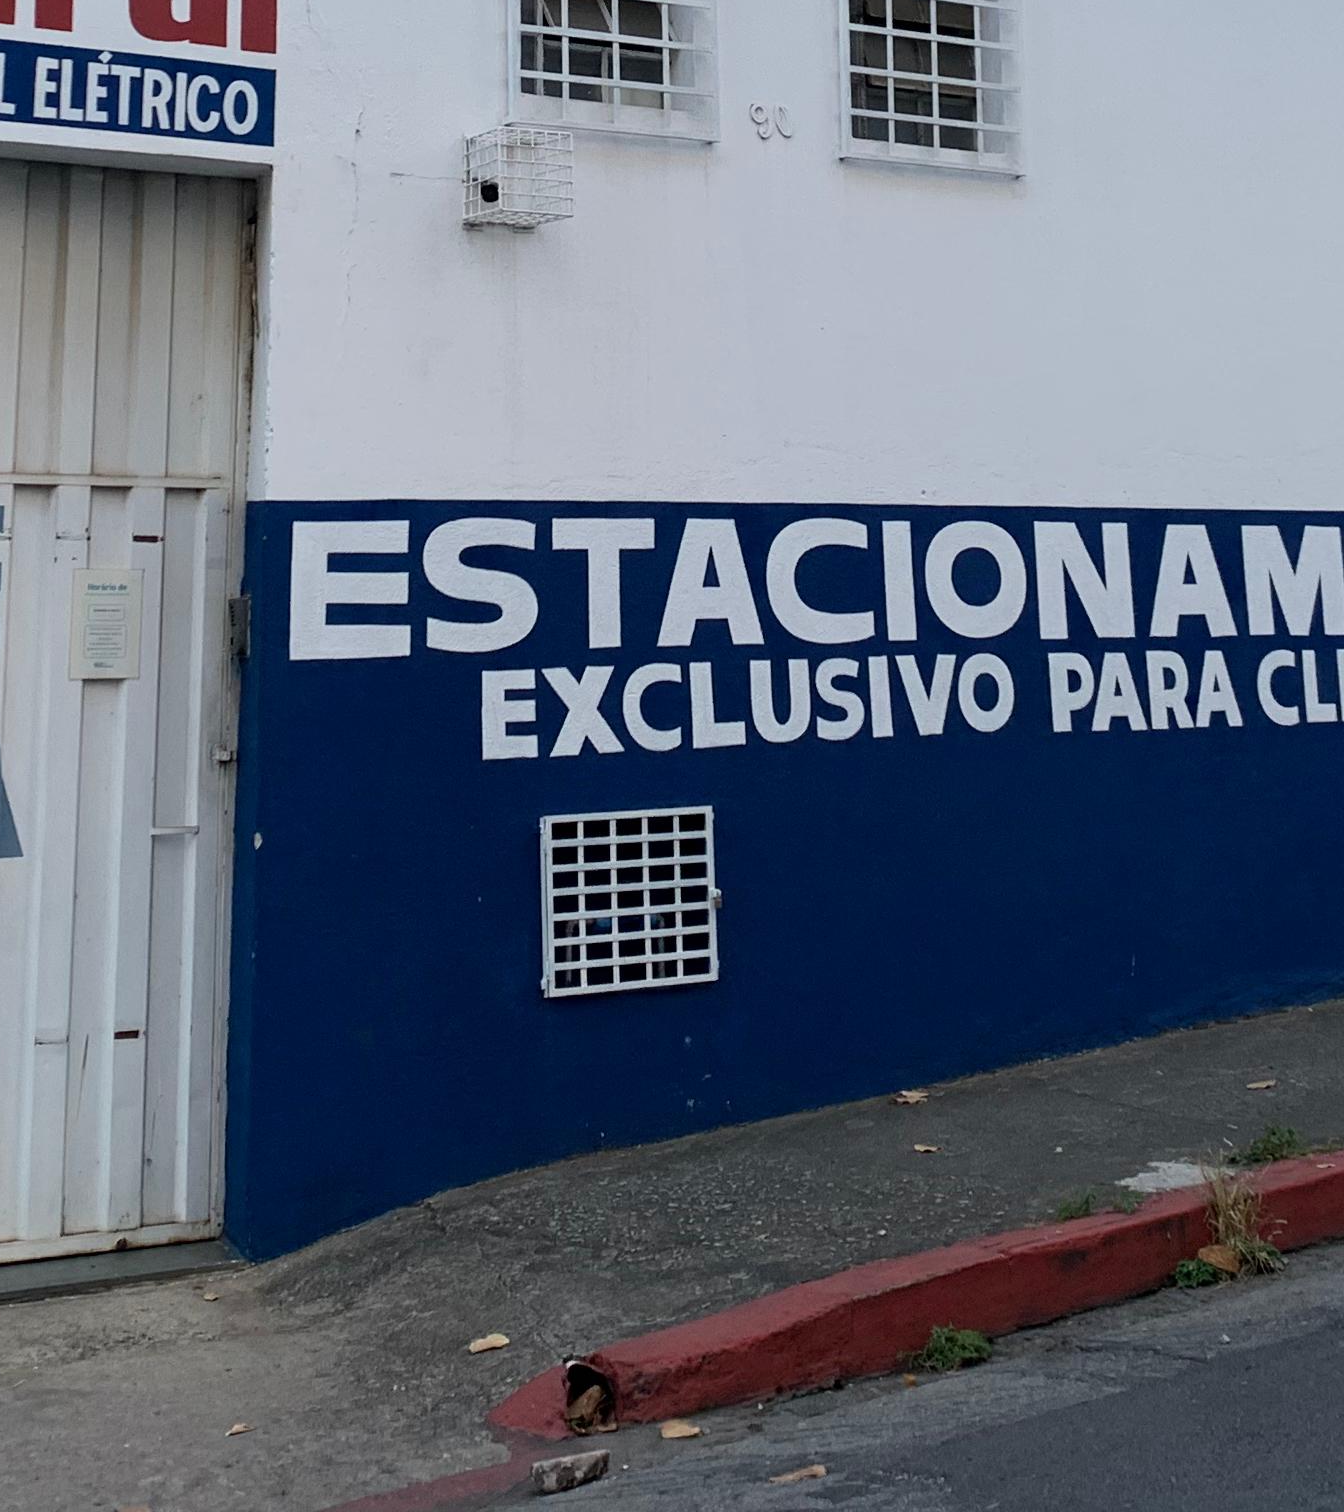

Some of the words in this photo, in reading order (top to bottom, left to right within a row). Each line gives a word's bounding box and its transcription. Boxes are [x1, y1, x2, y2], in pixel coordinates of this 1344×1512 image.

[32, 48, 260, 136] ELÉTRICO
[481, 652, 1016, 761] EXCLUSIVO
[1047, 649, 1244, 733] PARA
